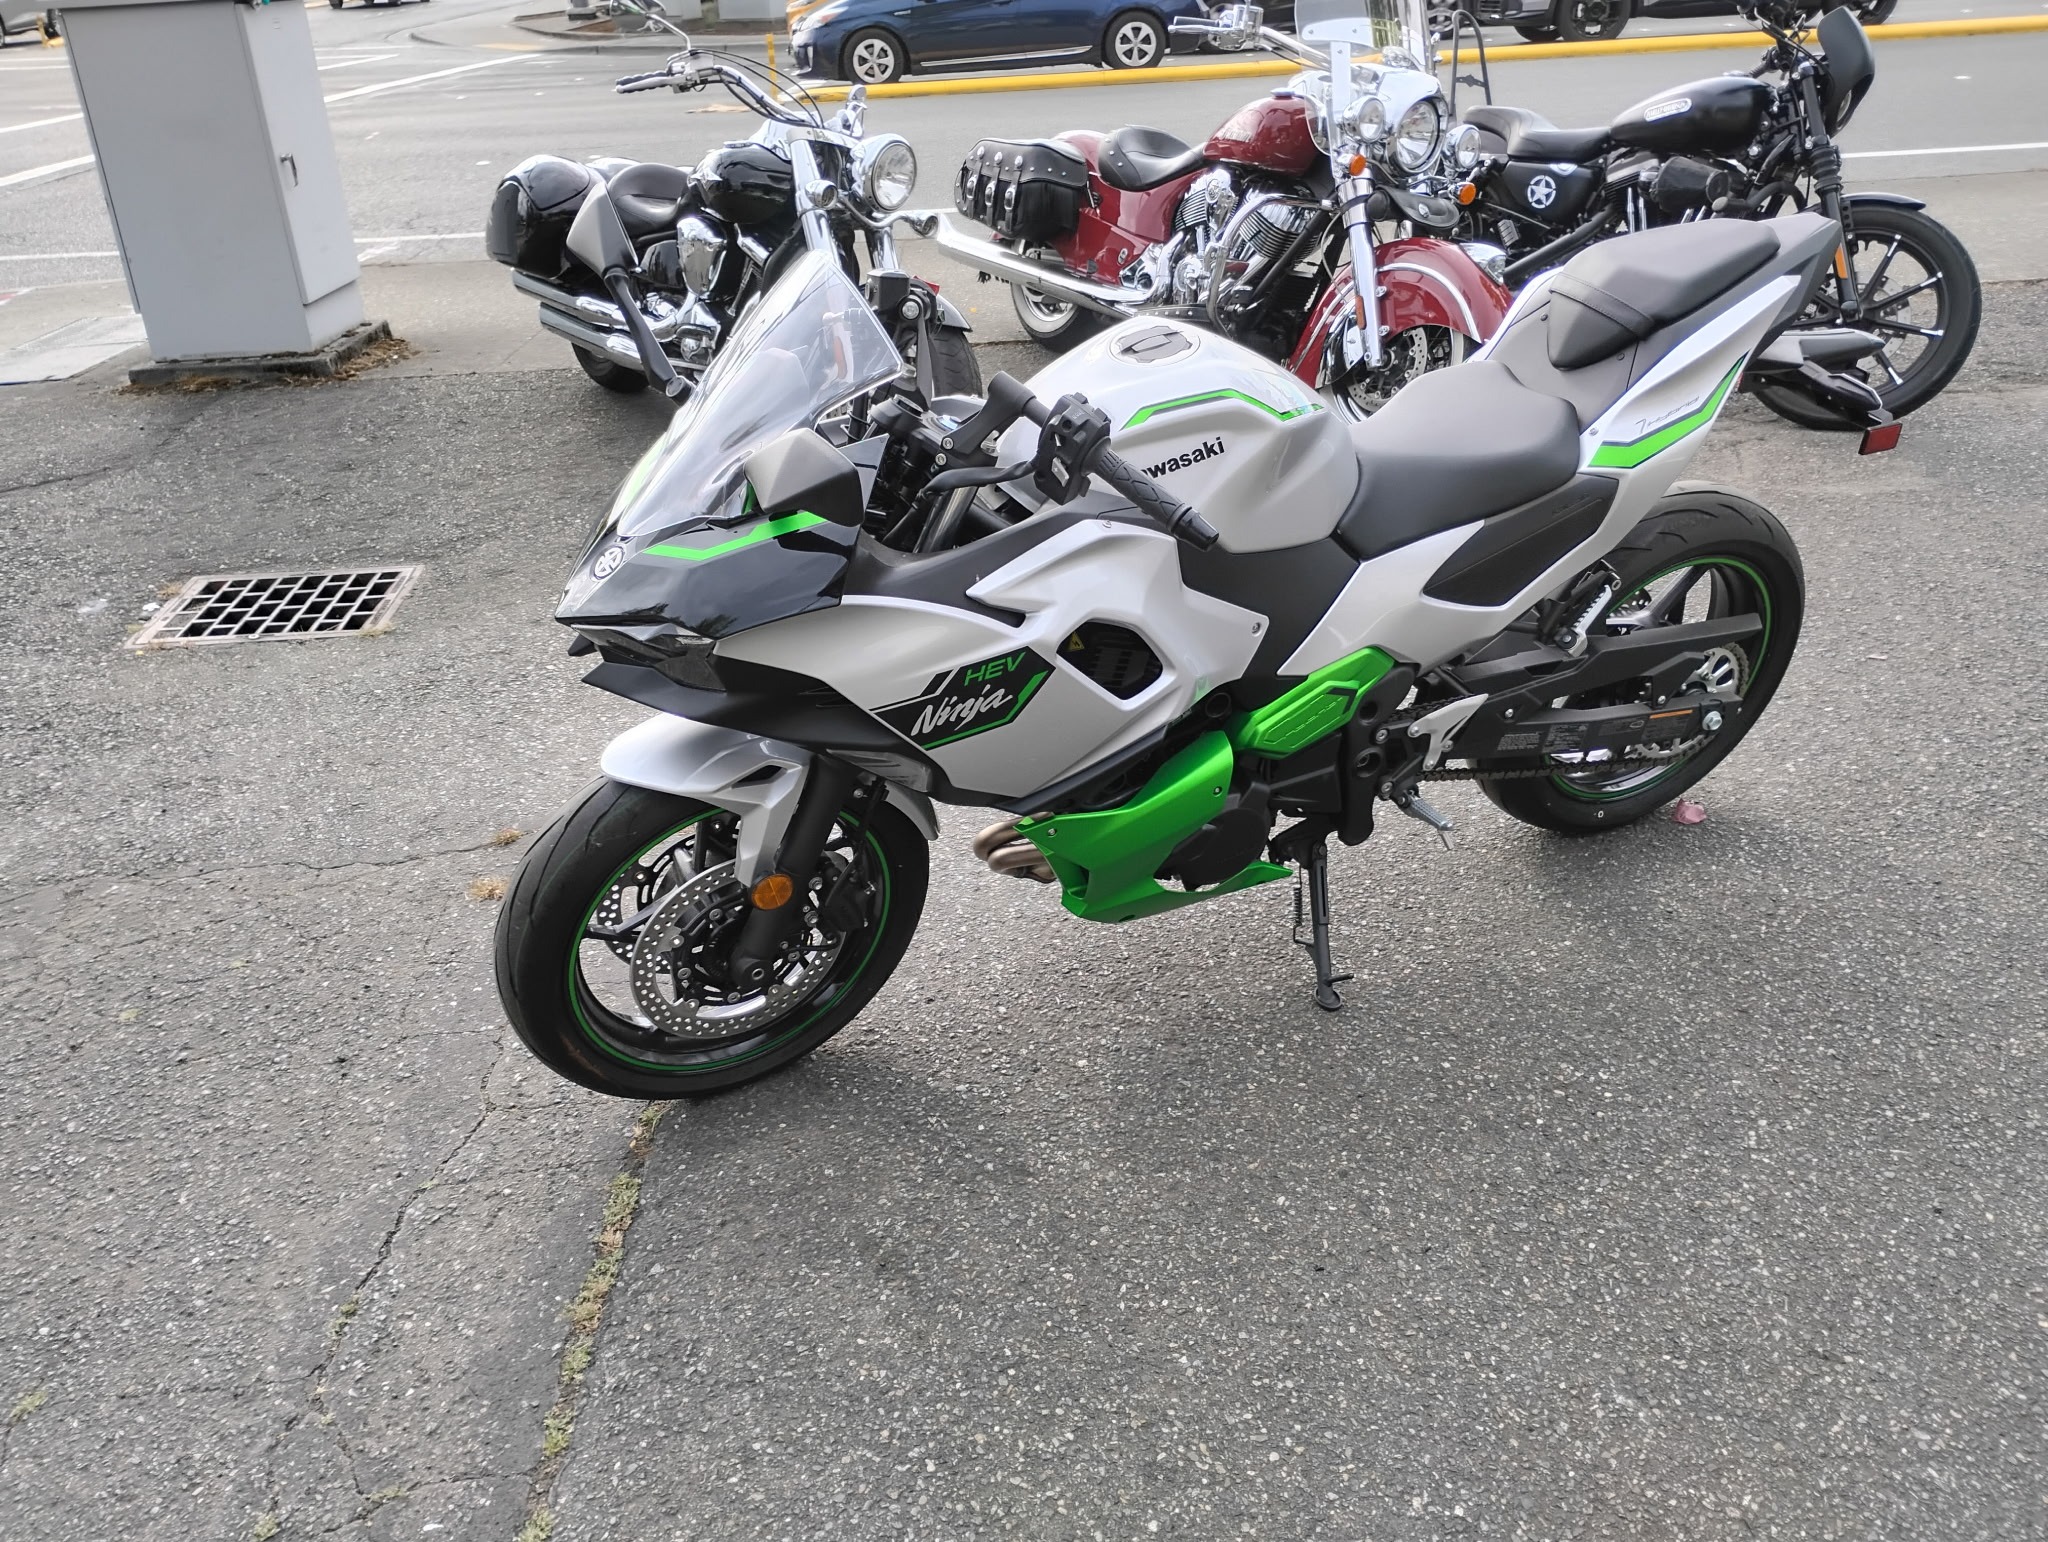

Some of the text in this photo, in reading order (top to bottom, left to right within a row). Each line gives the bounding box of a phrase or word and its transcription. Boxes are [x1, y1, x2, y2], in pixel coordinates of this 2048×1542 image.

[1140, 436, 1225, 479] wasaki
[963, 651, 1026, 687] HEV
[910, 684, 1013, 736] Ninja
